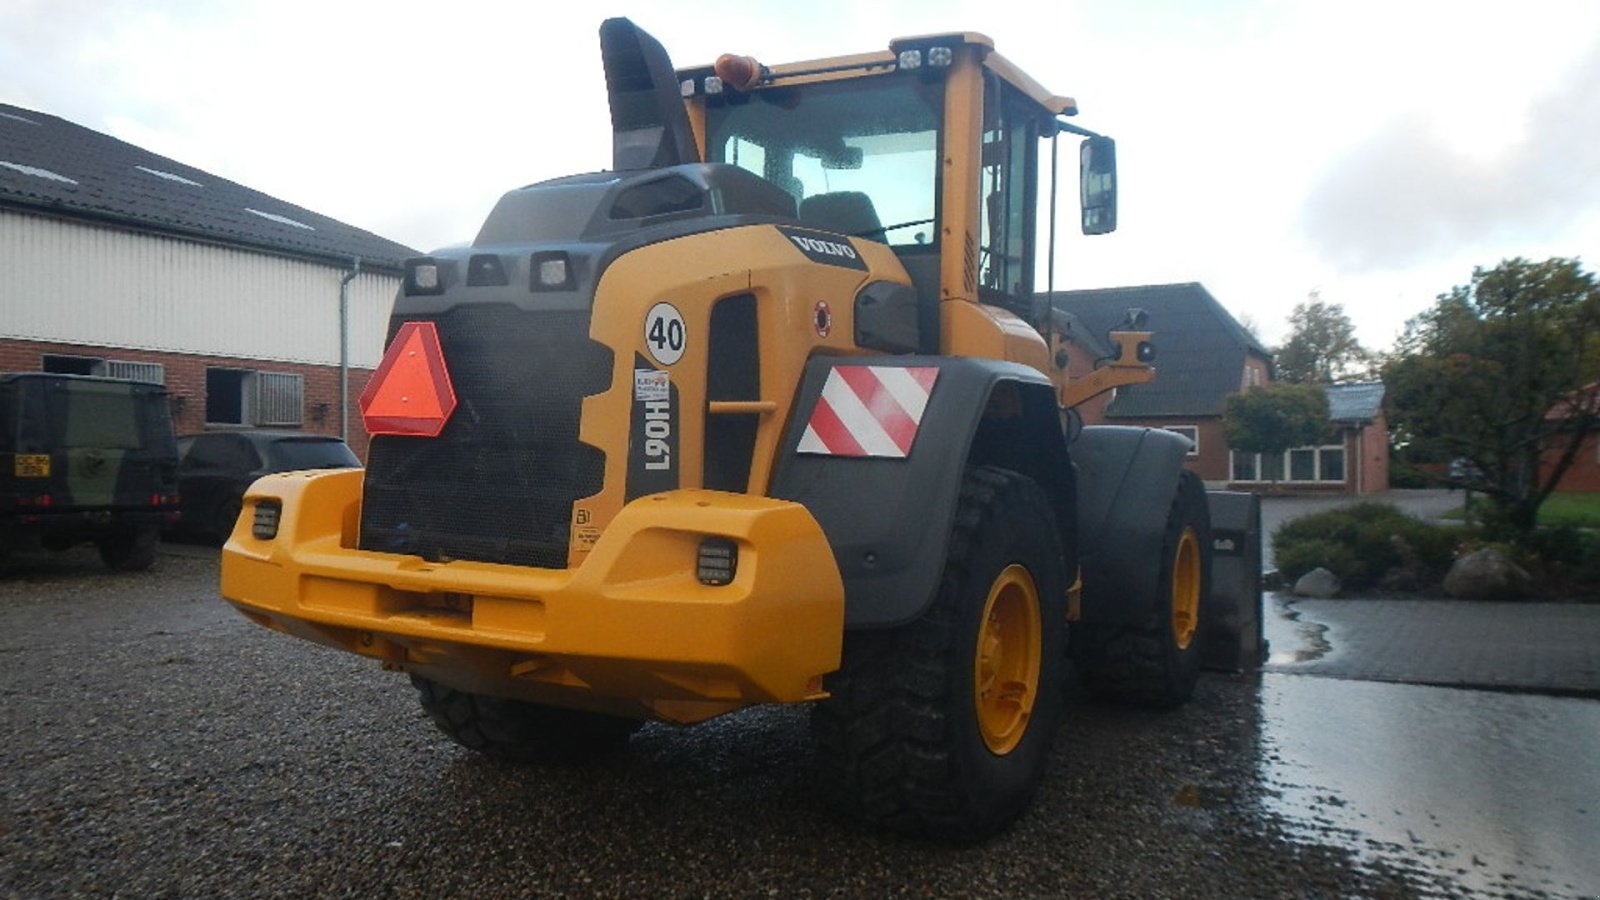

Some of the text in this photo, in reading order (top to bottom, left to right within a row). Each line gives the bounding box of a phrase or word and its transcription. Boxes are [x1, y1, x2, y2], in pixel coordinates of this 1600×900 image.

[791, 235, 856, 259] VOLVO
[649, 316, 684, 351] 40
[645, 401, 670, 470] L90H
